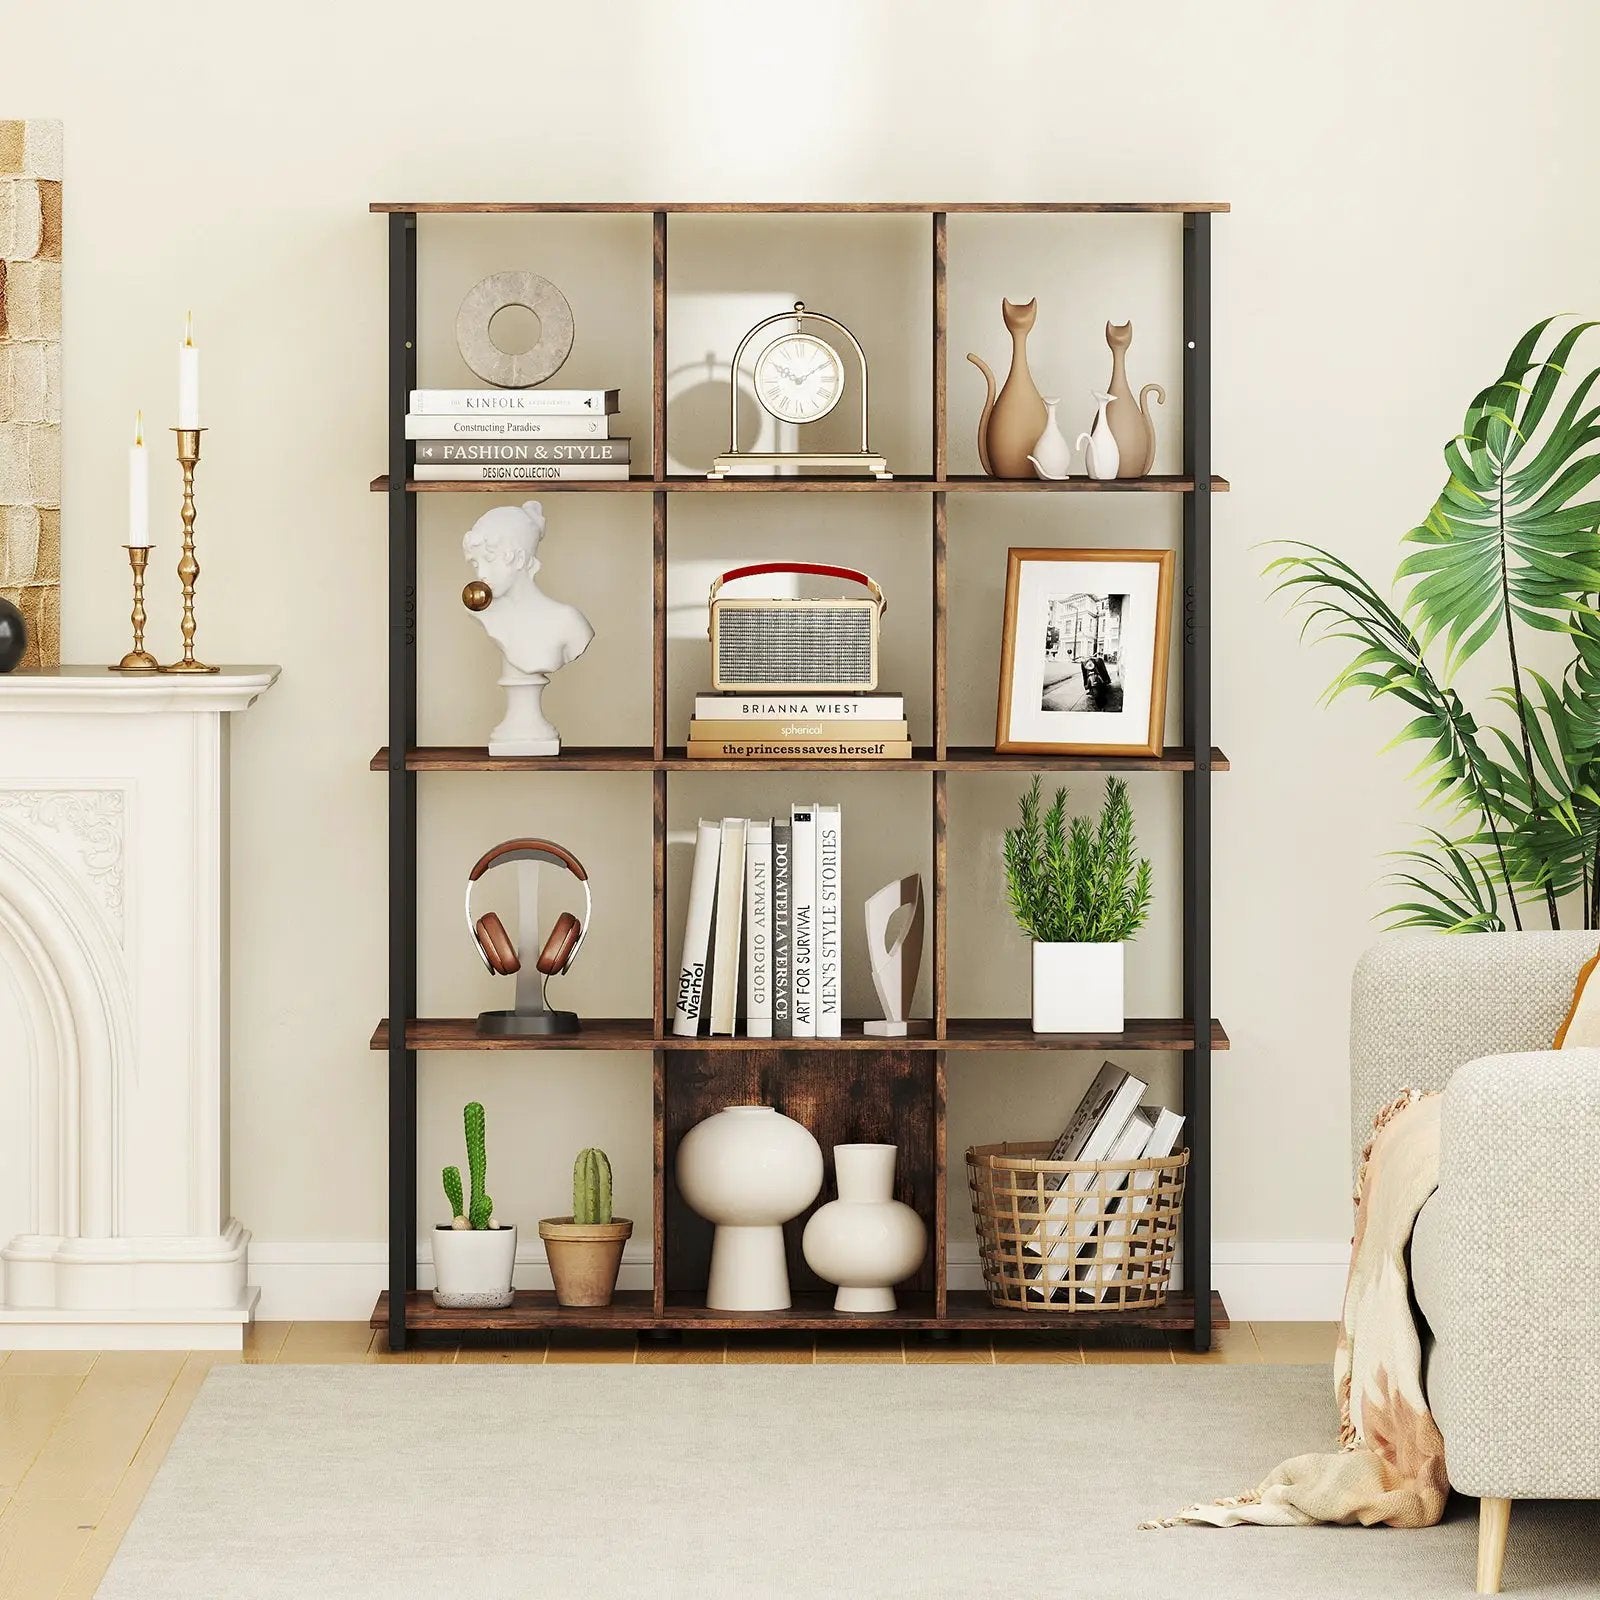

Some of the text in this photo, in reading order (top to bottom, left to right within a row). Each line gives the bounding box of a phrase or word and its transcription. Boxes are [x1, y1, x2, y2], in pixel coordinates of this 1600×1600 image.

[466, 398, 525, 409] KINFOLK
[453, 422, 541, 434] Constructing Paradies
[443, 445, 613, 459] FASHION & STYLE
[482, 467, 561, 479] DESIGN COLLECTION
[742, 704, 859, 714] BRIANNA WIEST
[781, 724, 823, 737] spherical
[722, 743, 886, 757] the princess saves herself
[821, 829, 837, 1014] MEN'S STYLE STORIES
[753, 862, 766, 1005] GIORGIO ARMANI
[775, 843, 788, 1020] DONATELLA VERSACE
[796, 904, 811, 1024] ART FOR SURVIVAL
[676, 967, 694, 1012] Andy
[687, 963, 704, 1020] Warhol
